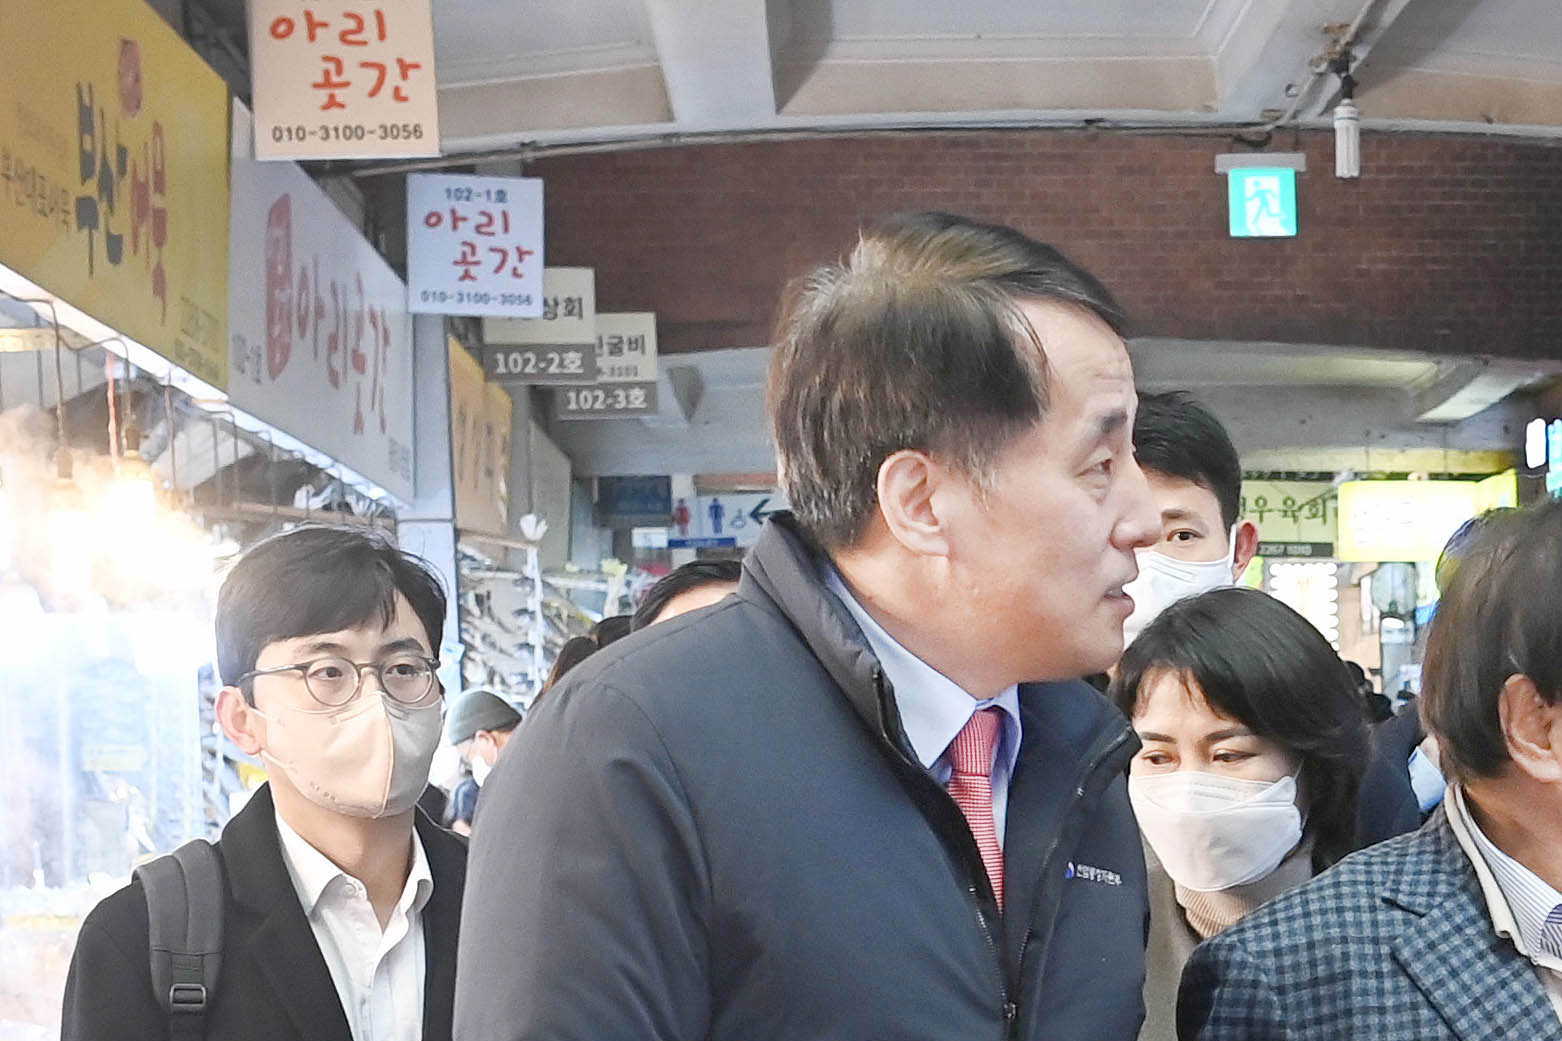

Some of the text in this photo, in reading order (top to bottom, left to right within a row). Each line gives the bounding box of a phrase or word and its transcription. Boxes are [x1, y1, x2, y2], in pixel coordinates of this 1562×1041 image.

[270, 9, 387, 46] 아리
[312, 55, 421, 110] 곳간
[272, 124, 423, 142] 010-3100-3056
[445, 188, 508, 203] 102-1호
[424, 208, 511, 236] 아리
[453, 241, 534, 282] 곳간
[495, 351, 584, 375] 102-2호
[566, 388, 647, 410] 102-3호
